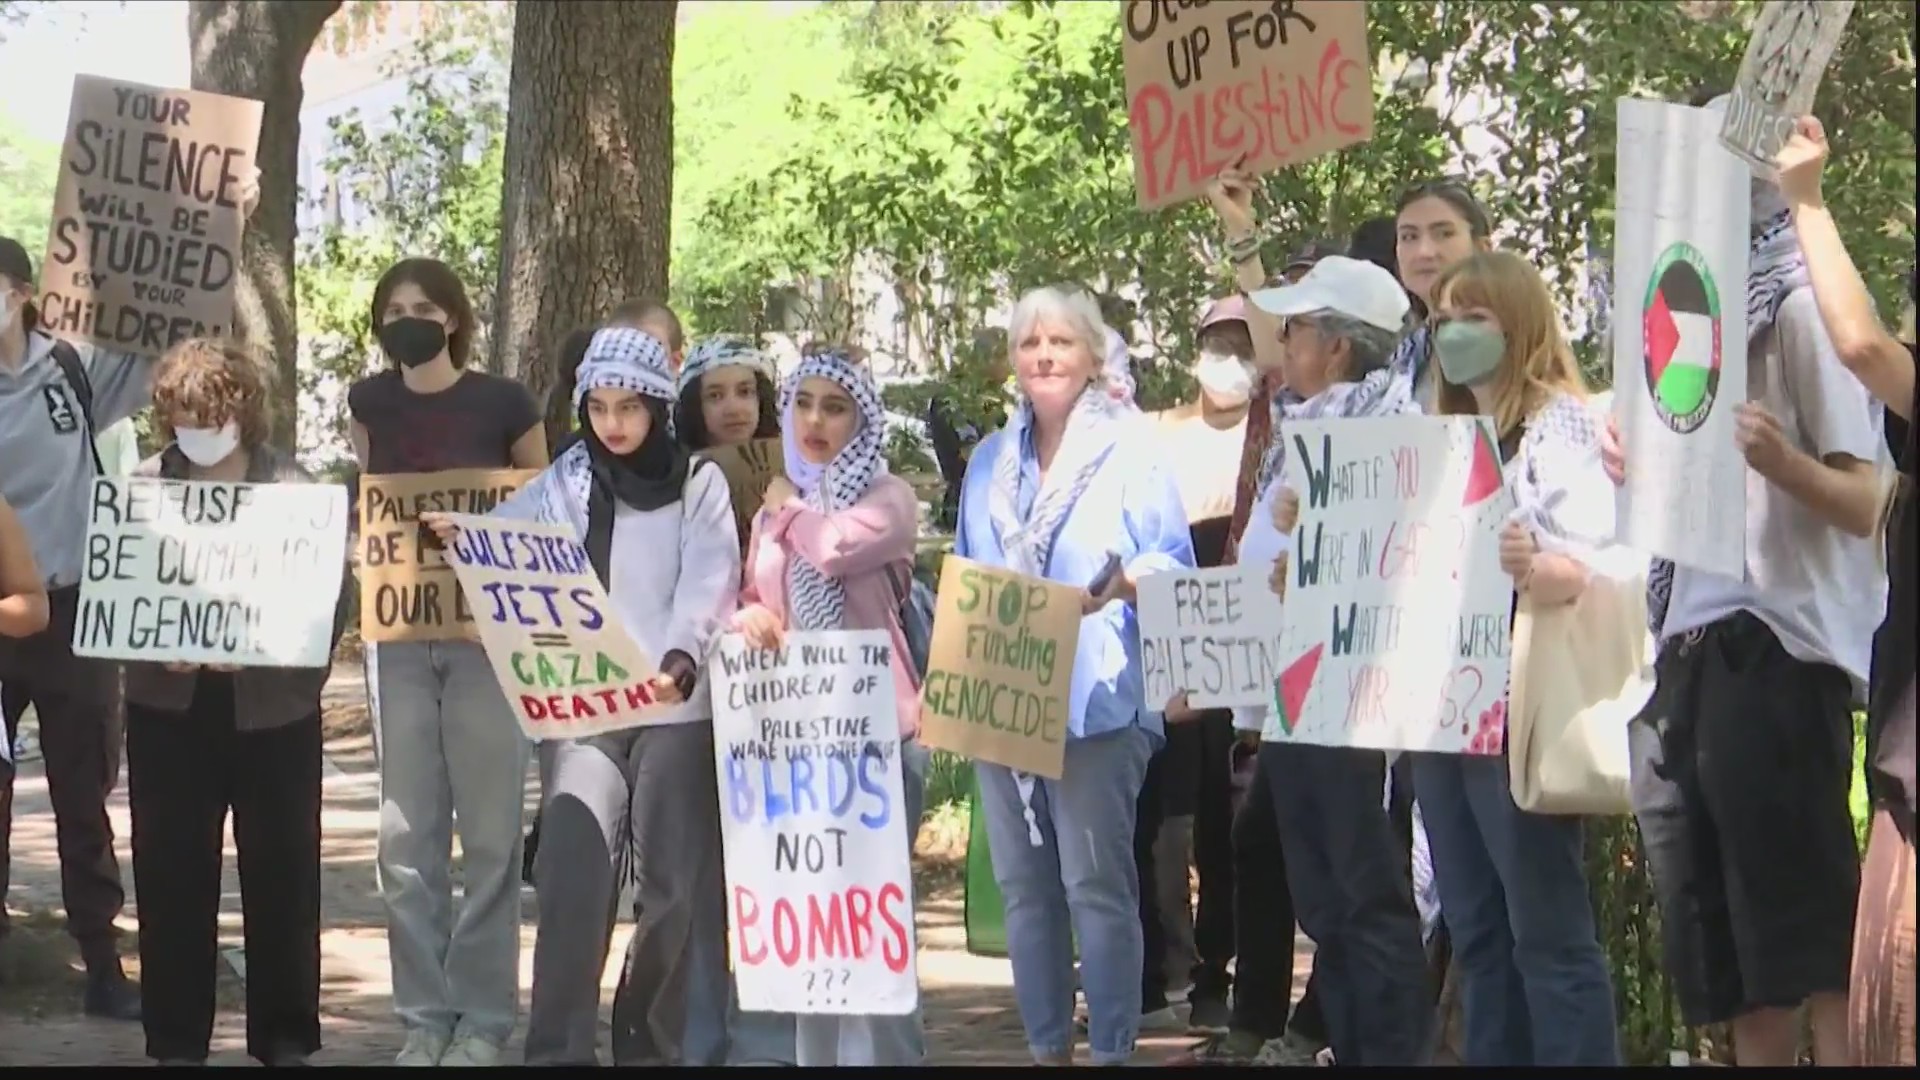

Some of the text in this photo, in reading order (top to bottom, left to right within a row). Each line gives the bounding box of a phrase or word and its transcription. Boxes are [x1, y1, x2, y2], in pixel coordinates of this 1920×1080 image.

[1167, 25, 1210, 90] UP
[1227, 0, 1318, 69] FOR
[113, 87, 191, 126] YOUR
[1725, 86, 1797, 159] DIVES
[171, 206, 210, 237] BE
[72, 271, 186, 307] BY YOUR
[1390, 445, 1420, 498] YOU
[88, 534, 144, 582] BE
[367, 532, 405, 566] BE
[375, 579, 443, 627] OUR
[482, 581, 604, 631] JETS
[957, 568, 1048, 626] STOP
[1174, 577, 1243, 627] FREE
[80, 596, 265, 654] IN GENOCI
[720, 645, 790, 678] WHEN
[801, 645, 849, 666] WILL
[1143, 633, 1281, 703] PALESTIN
[729, 674, 879, 710] CHIDREN OF
[924, 669, 1061, 744] GENOCIDE
[761, 716, 871, 742] PALESTINE
[775, 828, 848, 874] NOT
[733, 882, 909, 973] BOMBS
